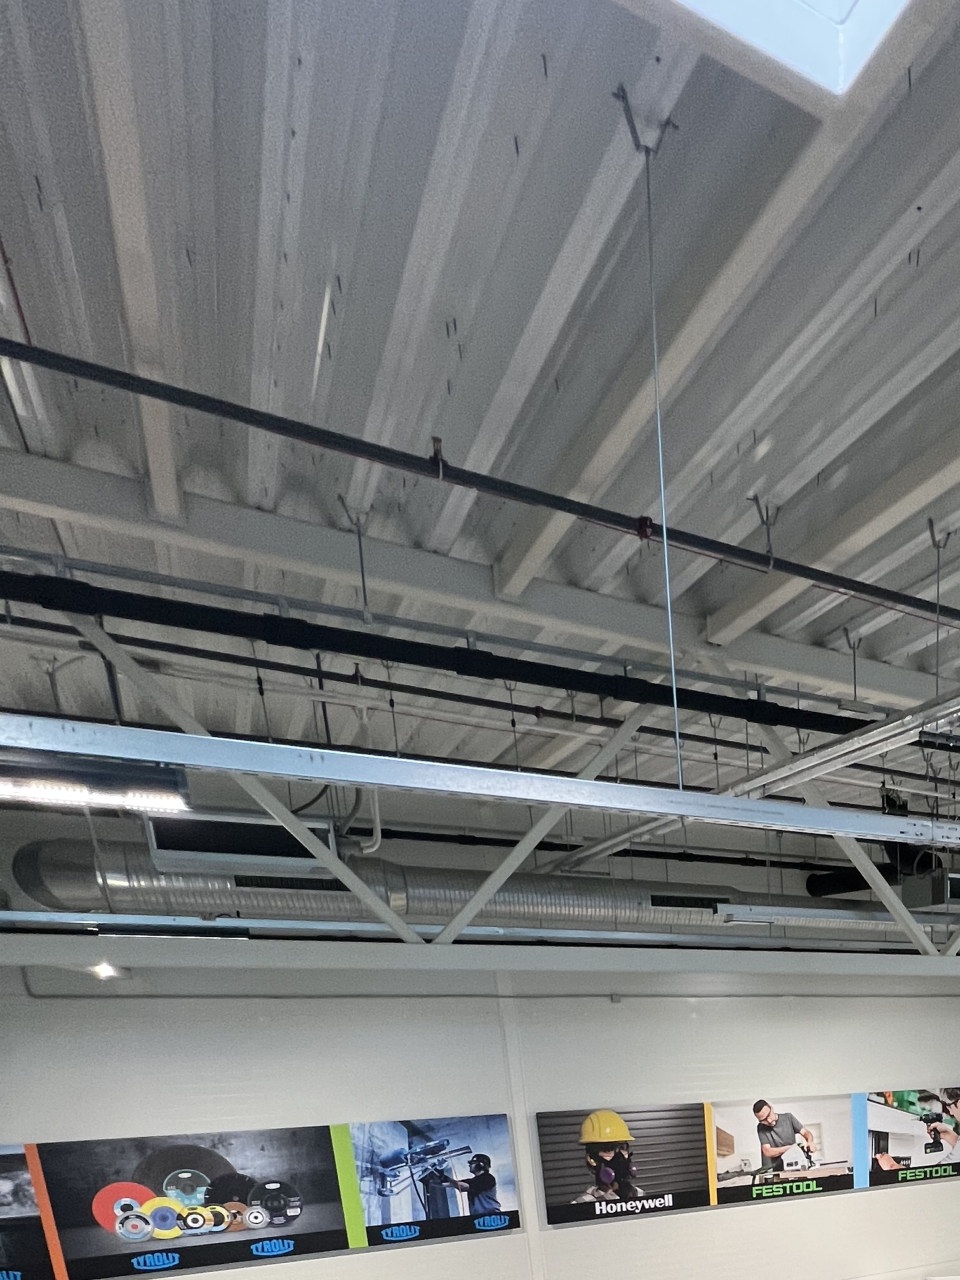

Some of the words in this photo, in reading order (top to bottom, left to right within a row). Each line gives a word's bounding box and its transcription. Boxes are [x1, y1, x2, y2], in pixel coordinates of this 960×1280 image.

[898, 1165, 958, 1181] FESTOOL
[752, 1180, 823, 1198] FESTOOL
[595, 1194, 673, 1216] Honeywell
[474, 1215, 510, 1230] TYROLIT
[381, 1225, 420, 1241] TYROLIT
[250, 1239, 295, 1256] TYROLIT
[131, 1252, 180, 1271] TYROLIT
